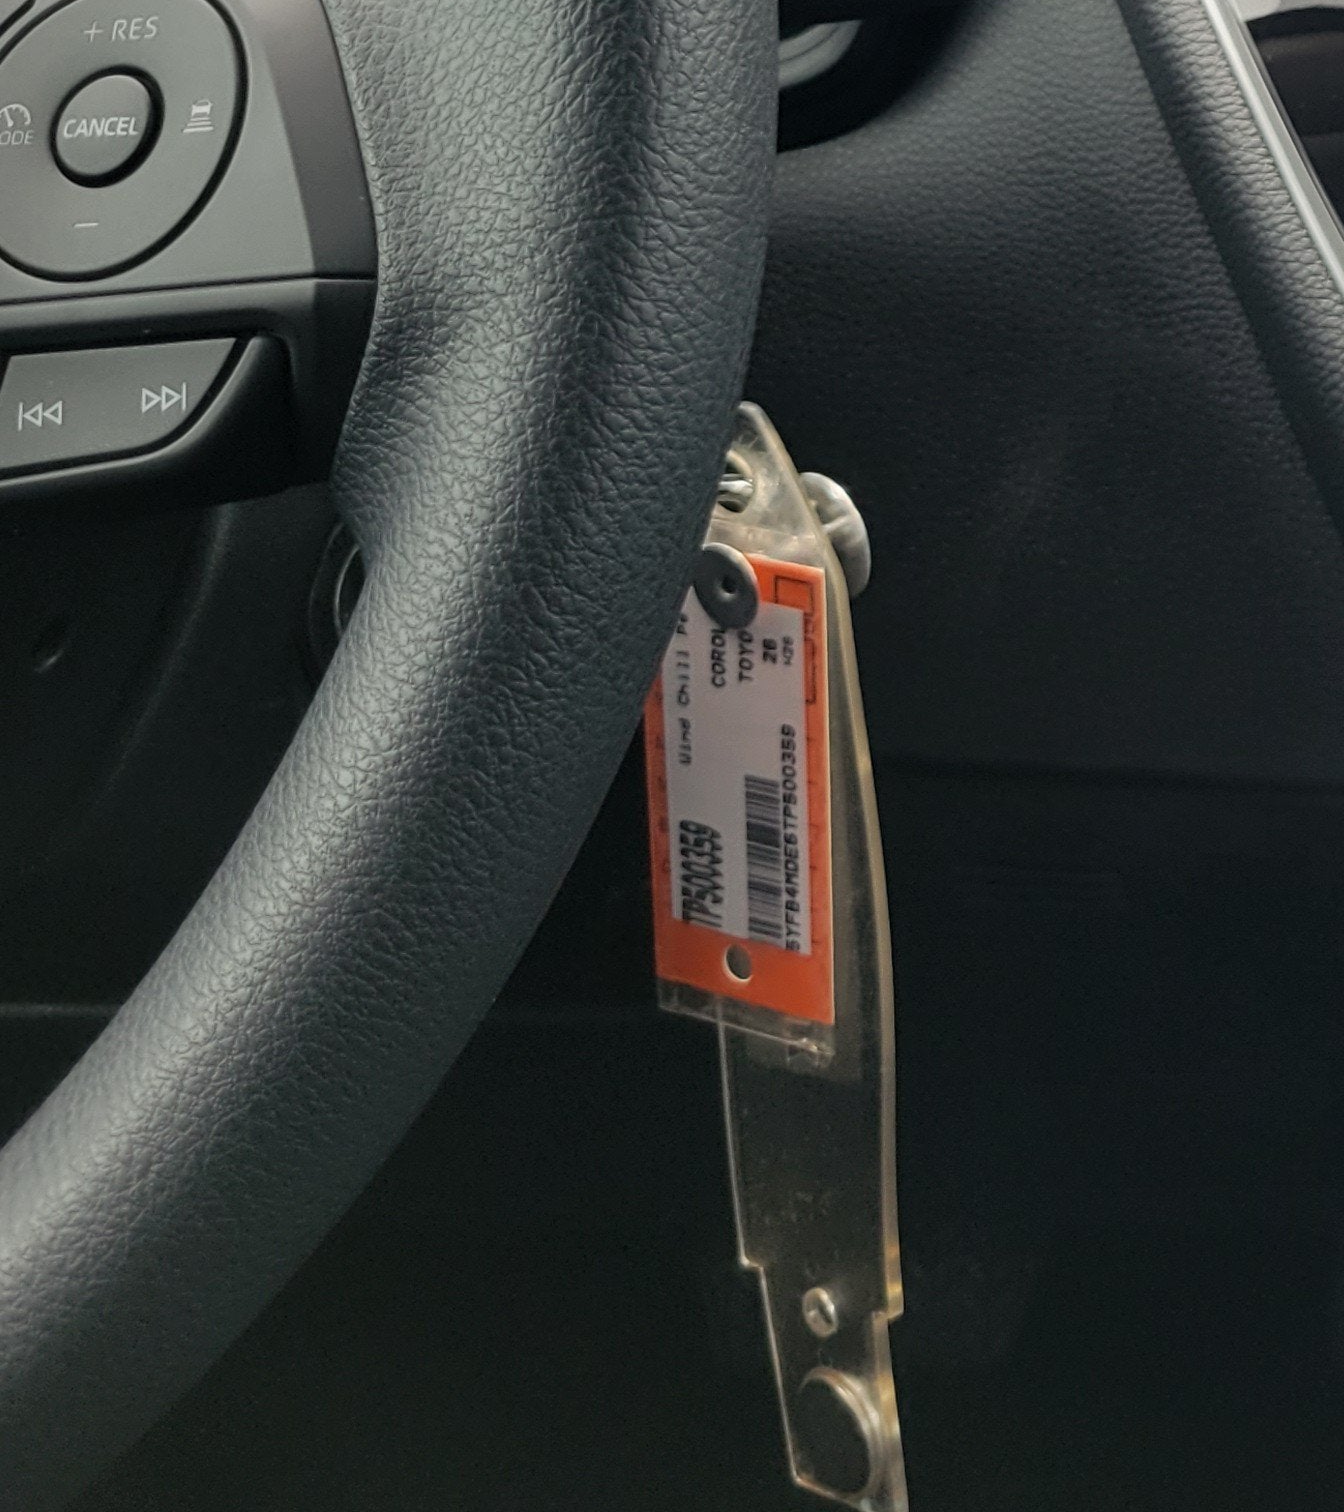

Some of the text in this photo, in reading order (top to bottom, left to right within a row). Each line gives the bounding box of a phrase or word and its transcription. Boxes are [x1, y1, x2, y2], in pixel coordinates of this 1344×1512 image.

[112, 16, 159, 42] RES
[63, 117, 139, 139] CANCEL
[676, 650, 690, 706] Chill
[678, 717, 692, 766] Wind
[781, 723, 801, 951] 5YFB4MDE6TP500359
[679, 819, 724, 928] TP500359
